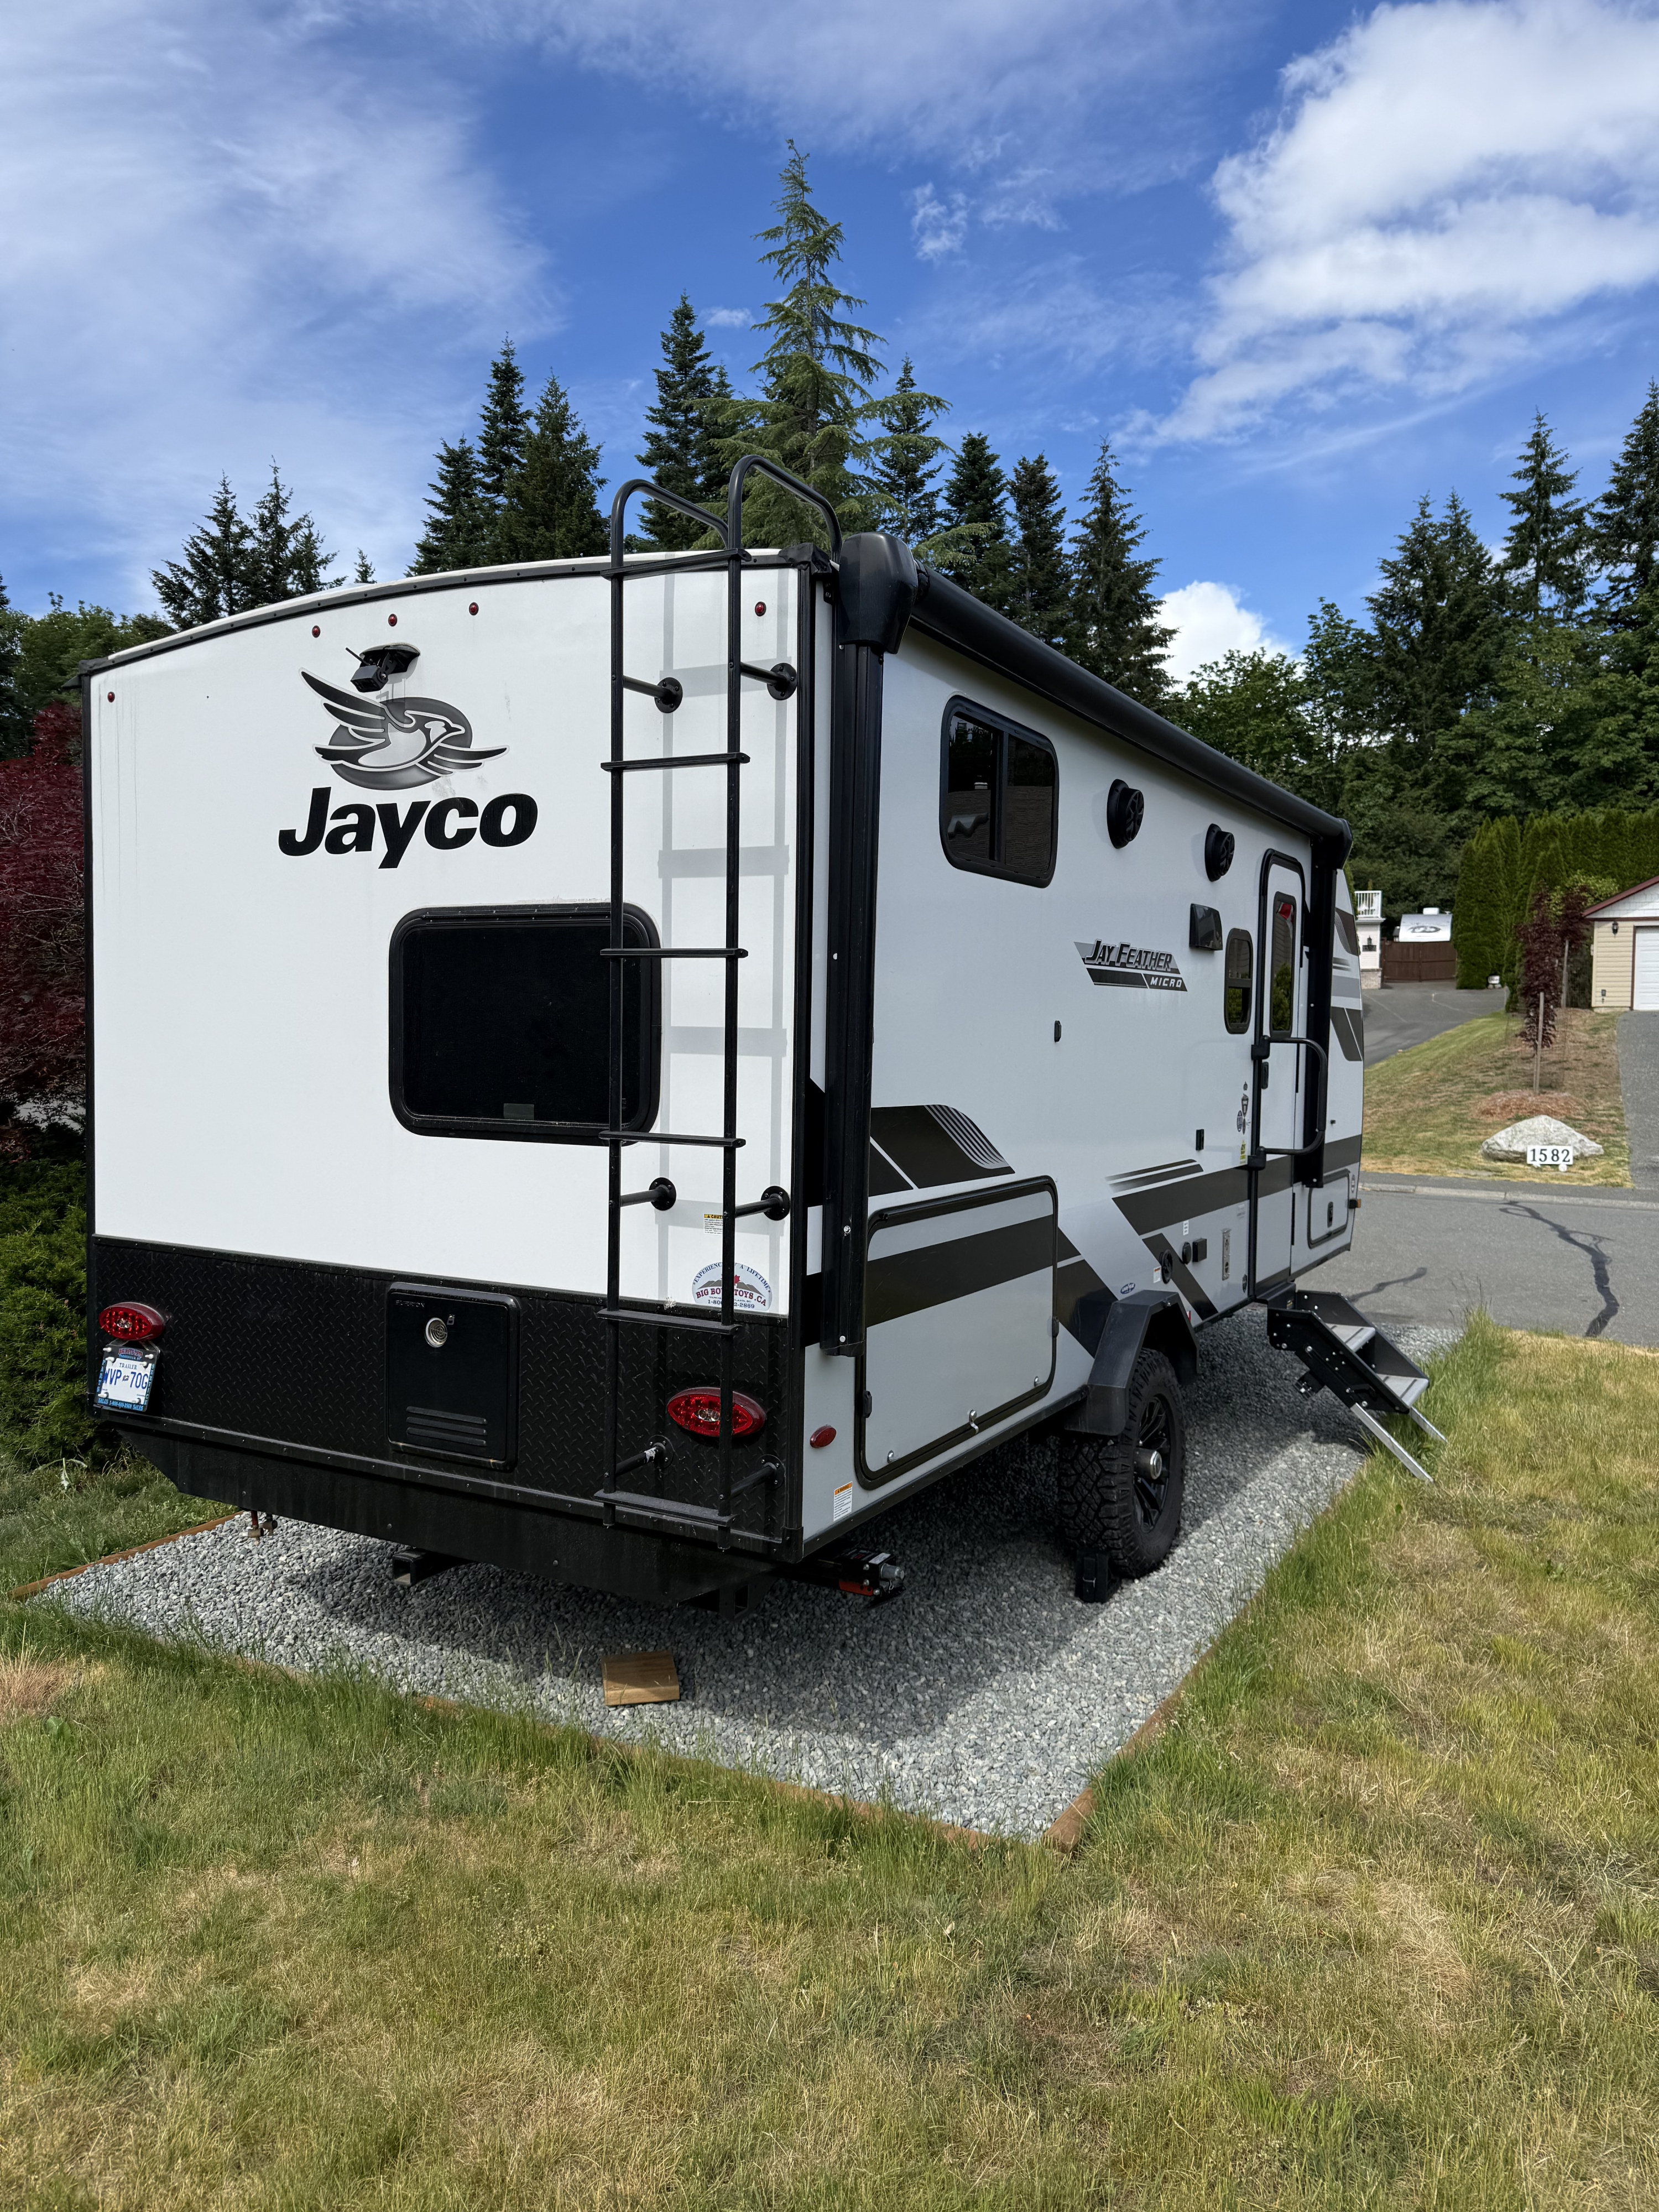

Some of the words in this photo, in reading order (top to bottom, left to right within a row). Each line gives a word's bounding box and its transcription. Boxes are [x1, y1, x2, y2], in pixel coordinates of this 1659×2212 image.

[278, 787, 538, 869] Jayco
[1085, 938, 1116, 966] JAY
[1115, 942, 1172, 972] FEATHER
[1150, 977, 1182, 988] MICRO
[1530, 1149, 1571, 1162] 1582
[694, 1262, 723, 1283] EXPERIENC
[747, 1267, 770, 1290] LIFETIME
[696, 1288, 709, 1298] BIG
